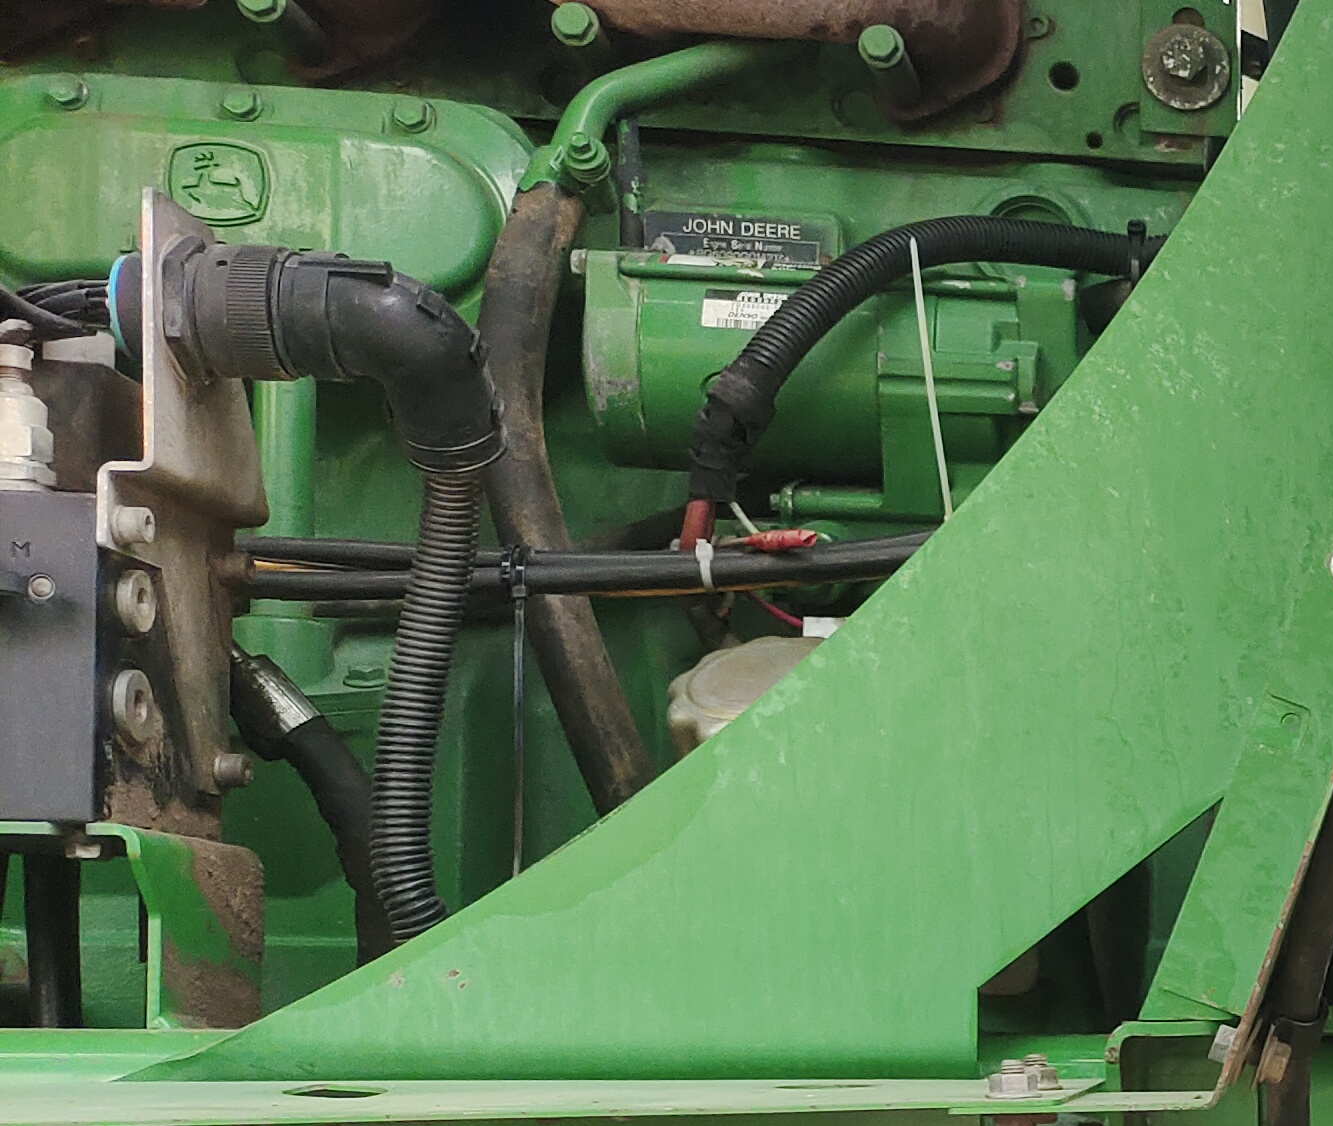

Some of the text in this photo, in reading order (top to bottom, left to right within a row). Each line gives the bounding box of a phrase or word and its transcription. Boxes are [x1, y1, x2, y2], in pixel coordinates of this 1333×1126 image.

[682, 218, 801, 239] JOHN DEERE
[10, 540, 31, 558] M
